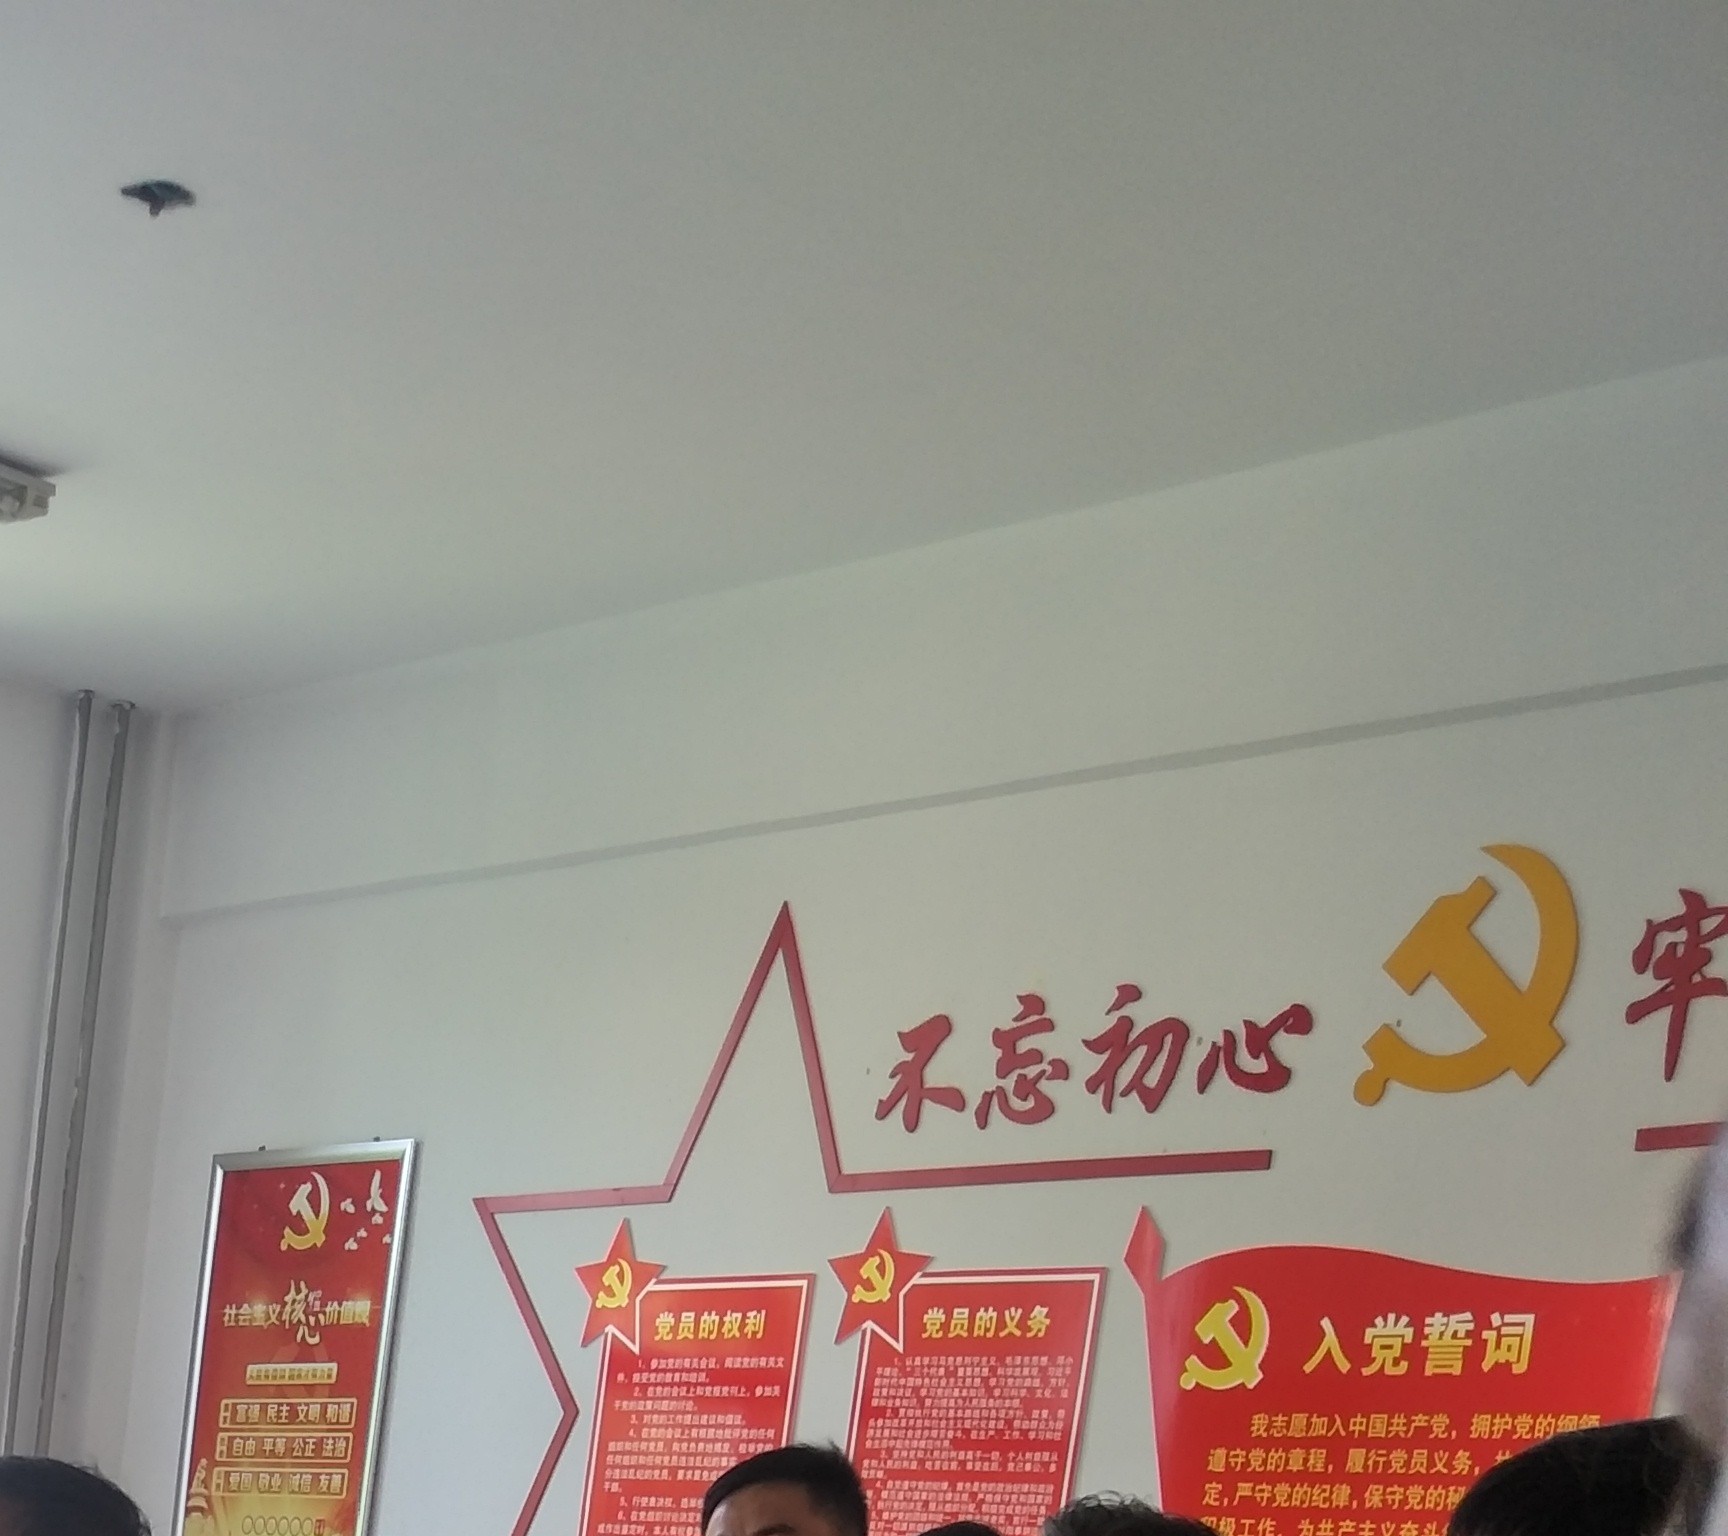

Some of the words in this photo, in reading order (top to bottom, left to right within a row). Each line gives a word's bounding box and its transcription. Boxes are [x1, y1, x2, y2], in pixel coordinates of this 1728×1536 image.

[1625, 887, 1728, 1083] 牢
[875, 984, 1314, 1133] 不忘初心
[654, 1309, 766, 1342] 党员的权利
[921, 1305, 1051, 1339] 党员的义务
[1302, 1311, 1537, 1376] 入党誓词
[235, 1404, 261, 1423] 富强
[266, 1404, 290, 1423] 民主
[296, 1404, 321, 1423] 文明
[325, 1403, 351, 1423] 和谐
[232, 1437, 256, 1457] 自由
[262, 1437, 287, 1457] 平等
[292, 1438, 317, 1457] 公正
[322, 1437, 347, 1458] 法治
[229, 1472, 253, 1492] 爱国
[258, 1472, 283, 1493] 敬业
[288, 1473, 313, 1493] 诚信
[318, 1474, 343, 1494] 友善
